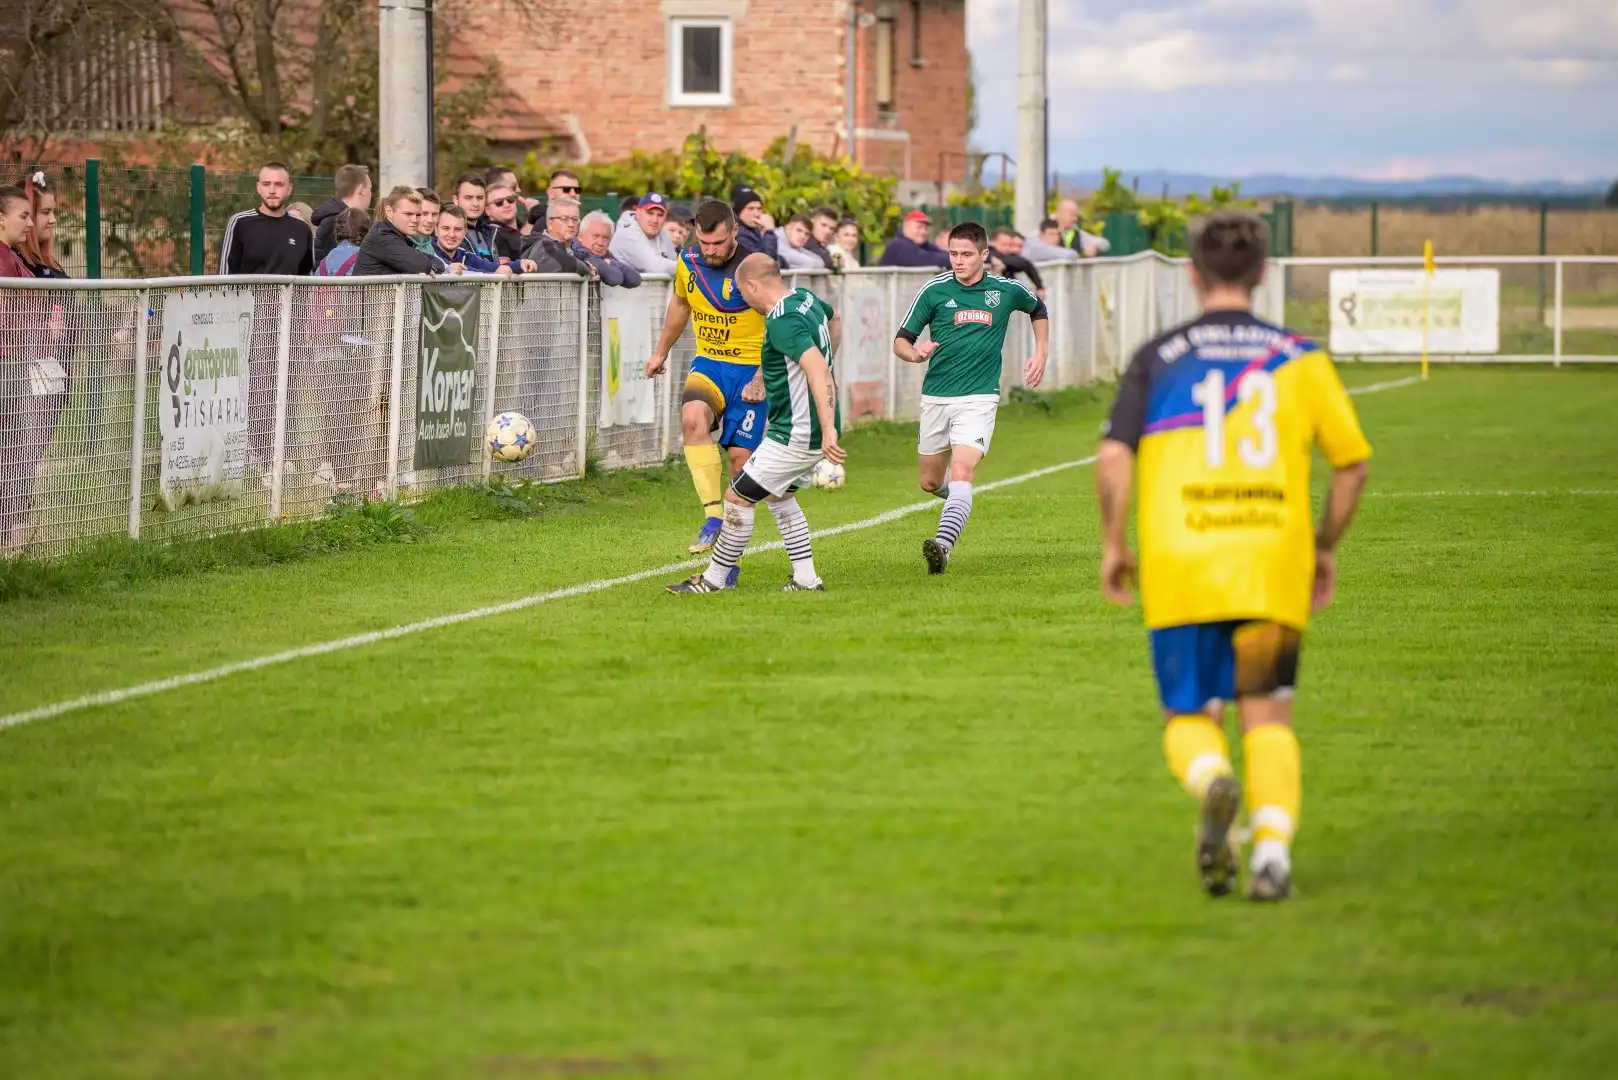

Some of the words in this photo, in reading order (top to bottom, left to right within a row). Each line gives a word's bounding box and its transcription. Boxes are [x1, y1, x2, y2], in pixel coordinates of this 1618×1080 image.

[687, 271, 696, 294] 8
[692, 310, 738, 327] gorenje
[703, 347, 741, 357] OBEC
[183, 337, 239, 396] grafoprom
[421, 347, 475, 436] Korpar
[418, 419, 435, 440] Auto
[741, 409, 756, 432] 8
[1191, 368, 1278, 468] 13
